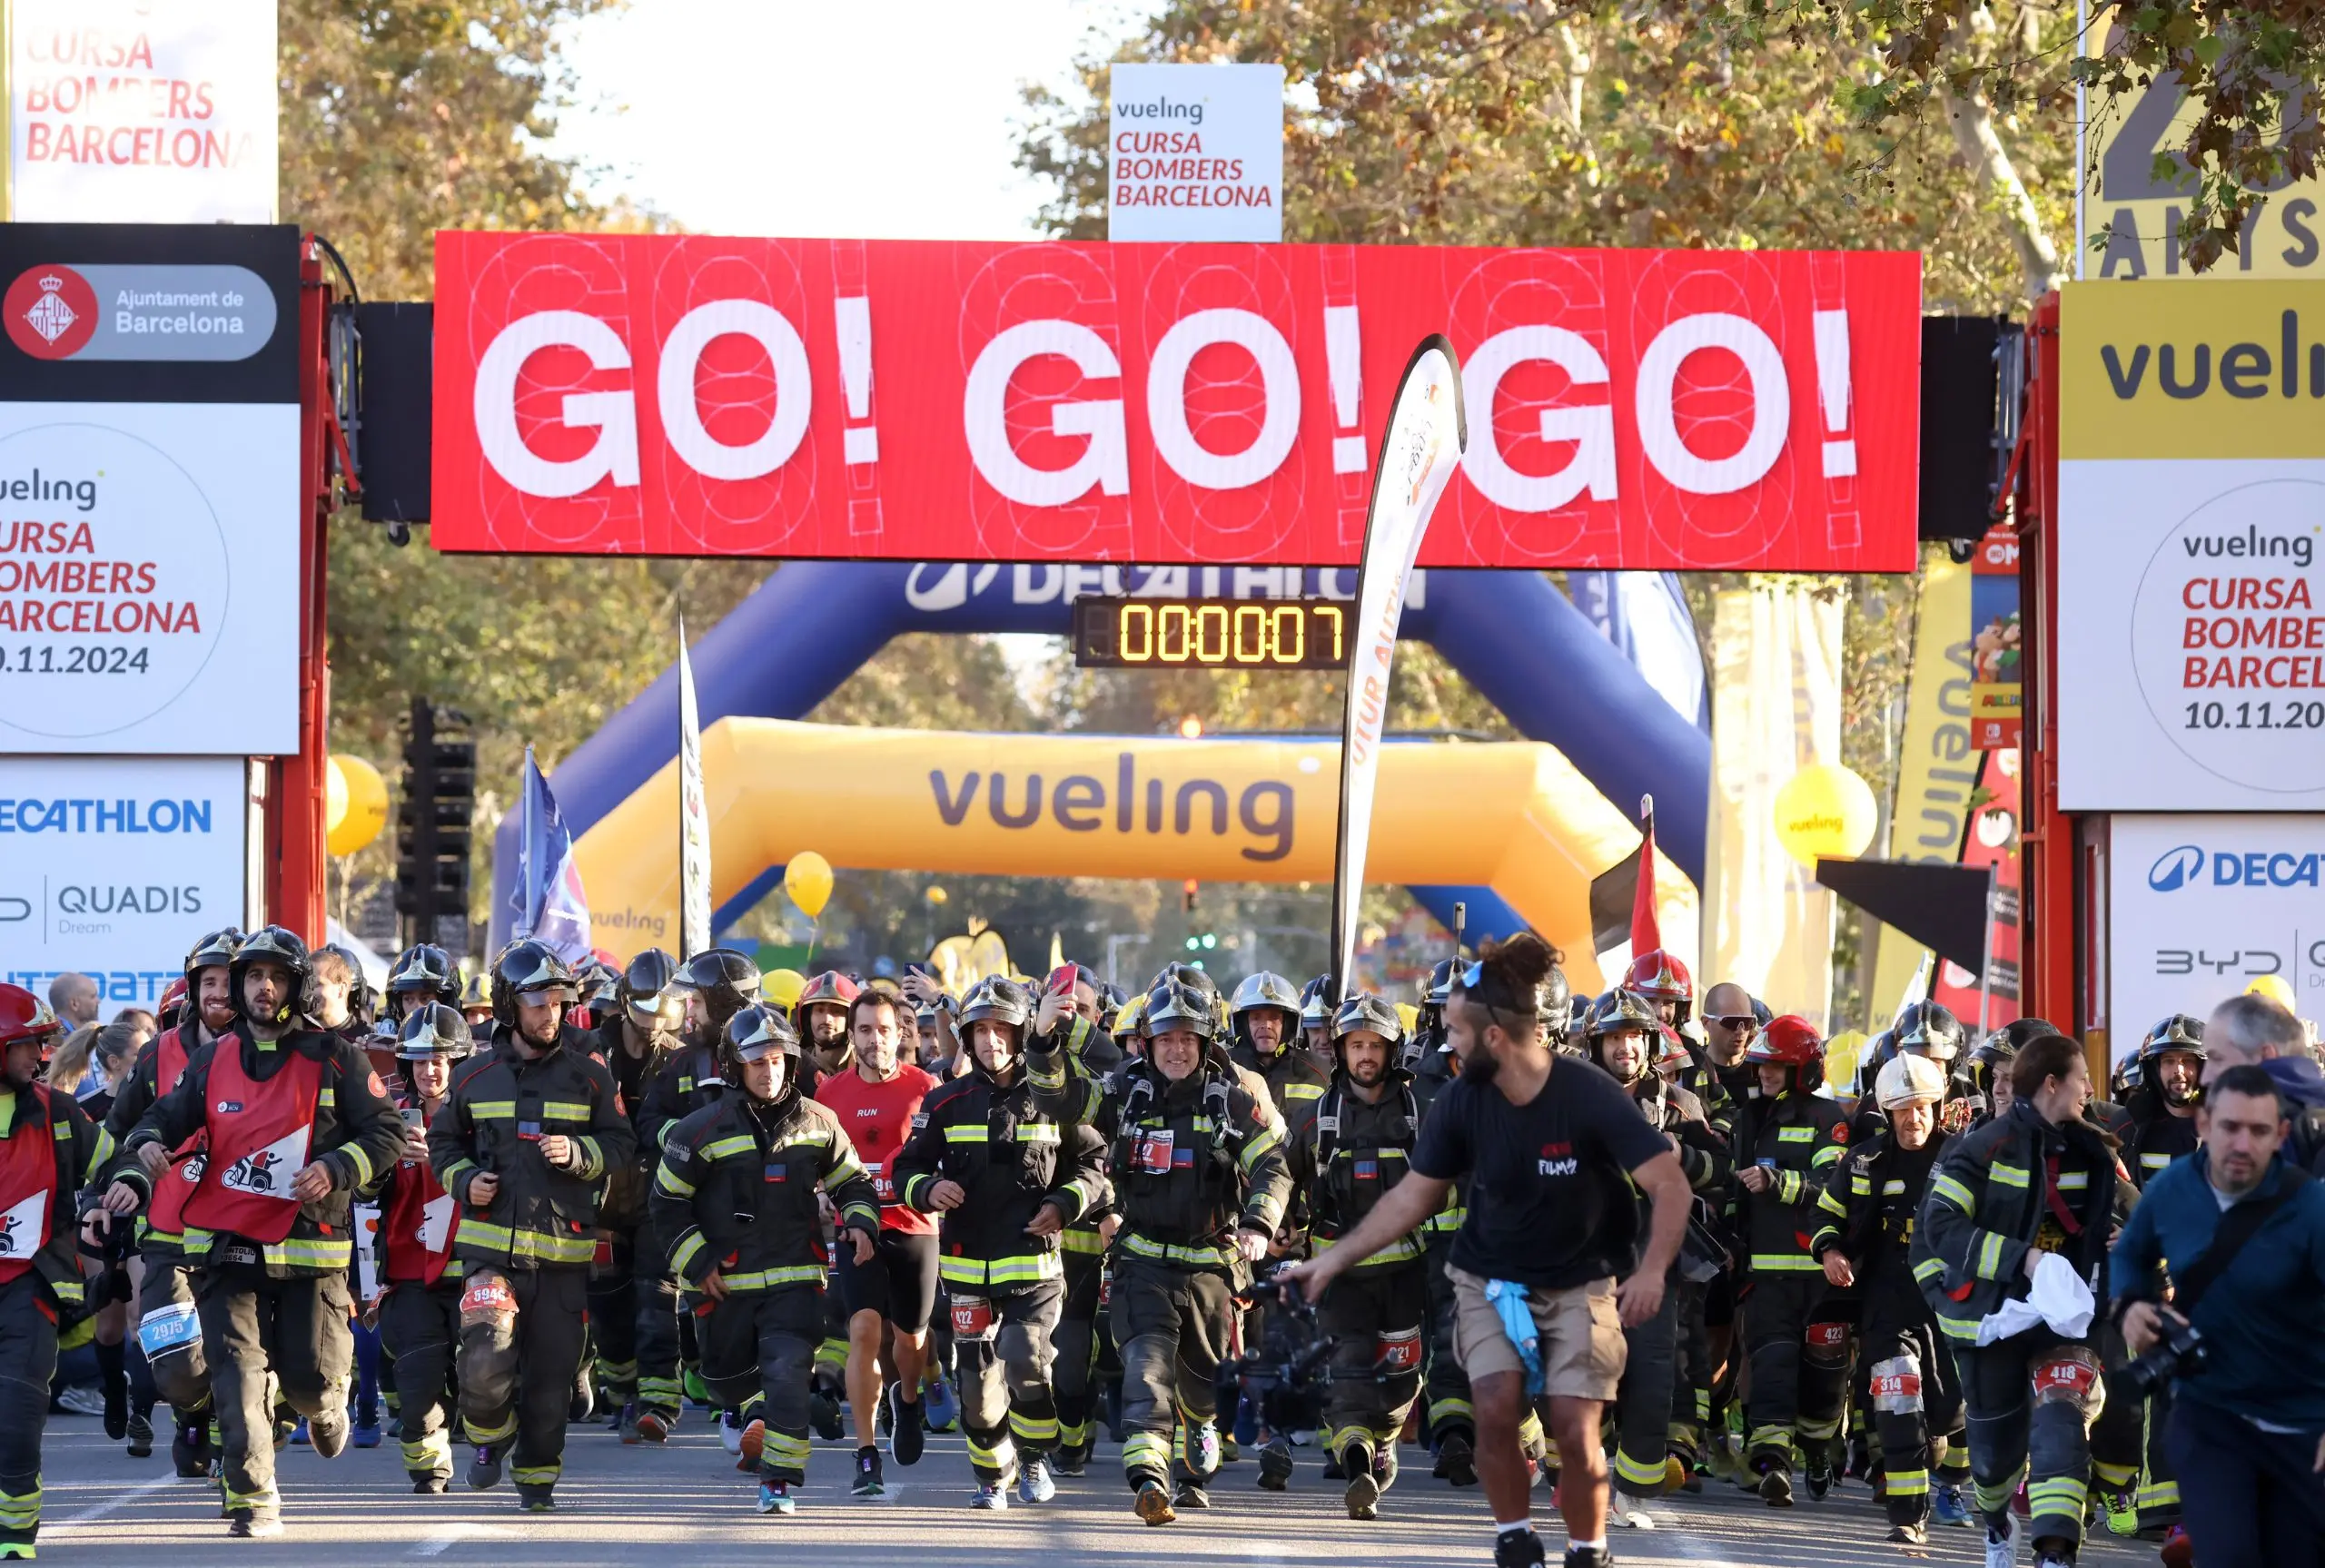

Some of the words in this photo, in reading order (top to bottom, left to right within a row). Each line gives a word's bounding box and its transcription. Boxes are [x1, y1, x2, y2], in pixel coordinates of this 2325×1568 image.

[26, 75, 213, 120] BOMERS
[1117, 95, 1203, 125] vueling
[1116, 132, 1202, 153] CURSA
[1116, 158, 1243, 181] BOMBERS
[1116, 184, 1272, 208] BARCELONA
[115, 288, 217, 309] Ajuntament
[222, 289, 244, 307] de
[115, 311, 244, 334] Barcelona
[2101, 309, 2325, 399] vueli
[473, 295, 879, 499] GO!
[964, 304, 1369, 508] GO!
[1460, 310, 1857, 513] GO!
[0, 468, 96, 511] eling
[0, 521, 95, 554] URSA
[2183, 524, 2312, 567] vueling
[0, 560, 157, 594] OMBERS
[2182, 577, 2311, 610] CURSA
[0, 600, 201, 633] ARCELONA
[1120, 604, 1342, 663] 00:00:07
[2182, 617, 2325, 649] BOMBE
[0, 646, 149, 674] .11.2024
[2182, 656, 2325, 688] BARCEL
[2184, 702, 2325, 729] 10.11.20
[1917, 638, 1977, 863] vuelin
[0, 799, 211, 833] ECATHLON
[929, 752, 1295, 862] vueling
[1788, 814, 1844, 833] vueling
[2213, 853, 2325, 886] DECA
[58, 886, 202, 914] QUADIS
[58, 919, 112, 934] Dream
[589, 907, 666, 938] vueling
[2156, 950, 2282, 975] BYD
[856, 1108, 878, 1118] RUN
[152, 1319, 184, 1340] 2975
[955, 1310, 973, 1325] 422
[1825, 1326, 1843, 1340] 423
[1880, 1377, 1903, 1391] 314
[2050, 1365, 2076, 1380] 418
